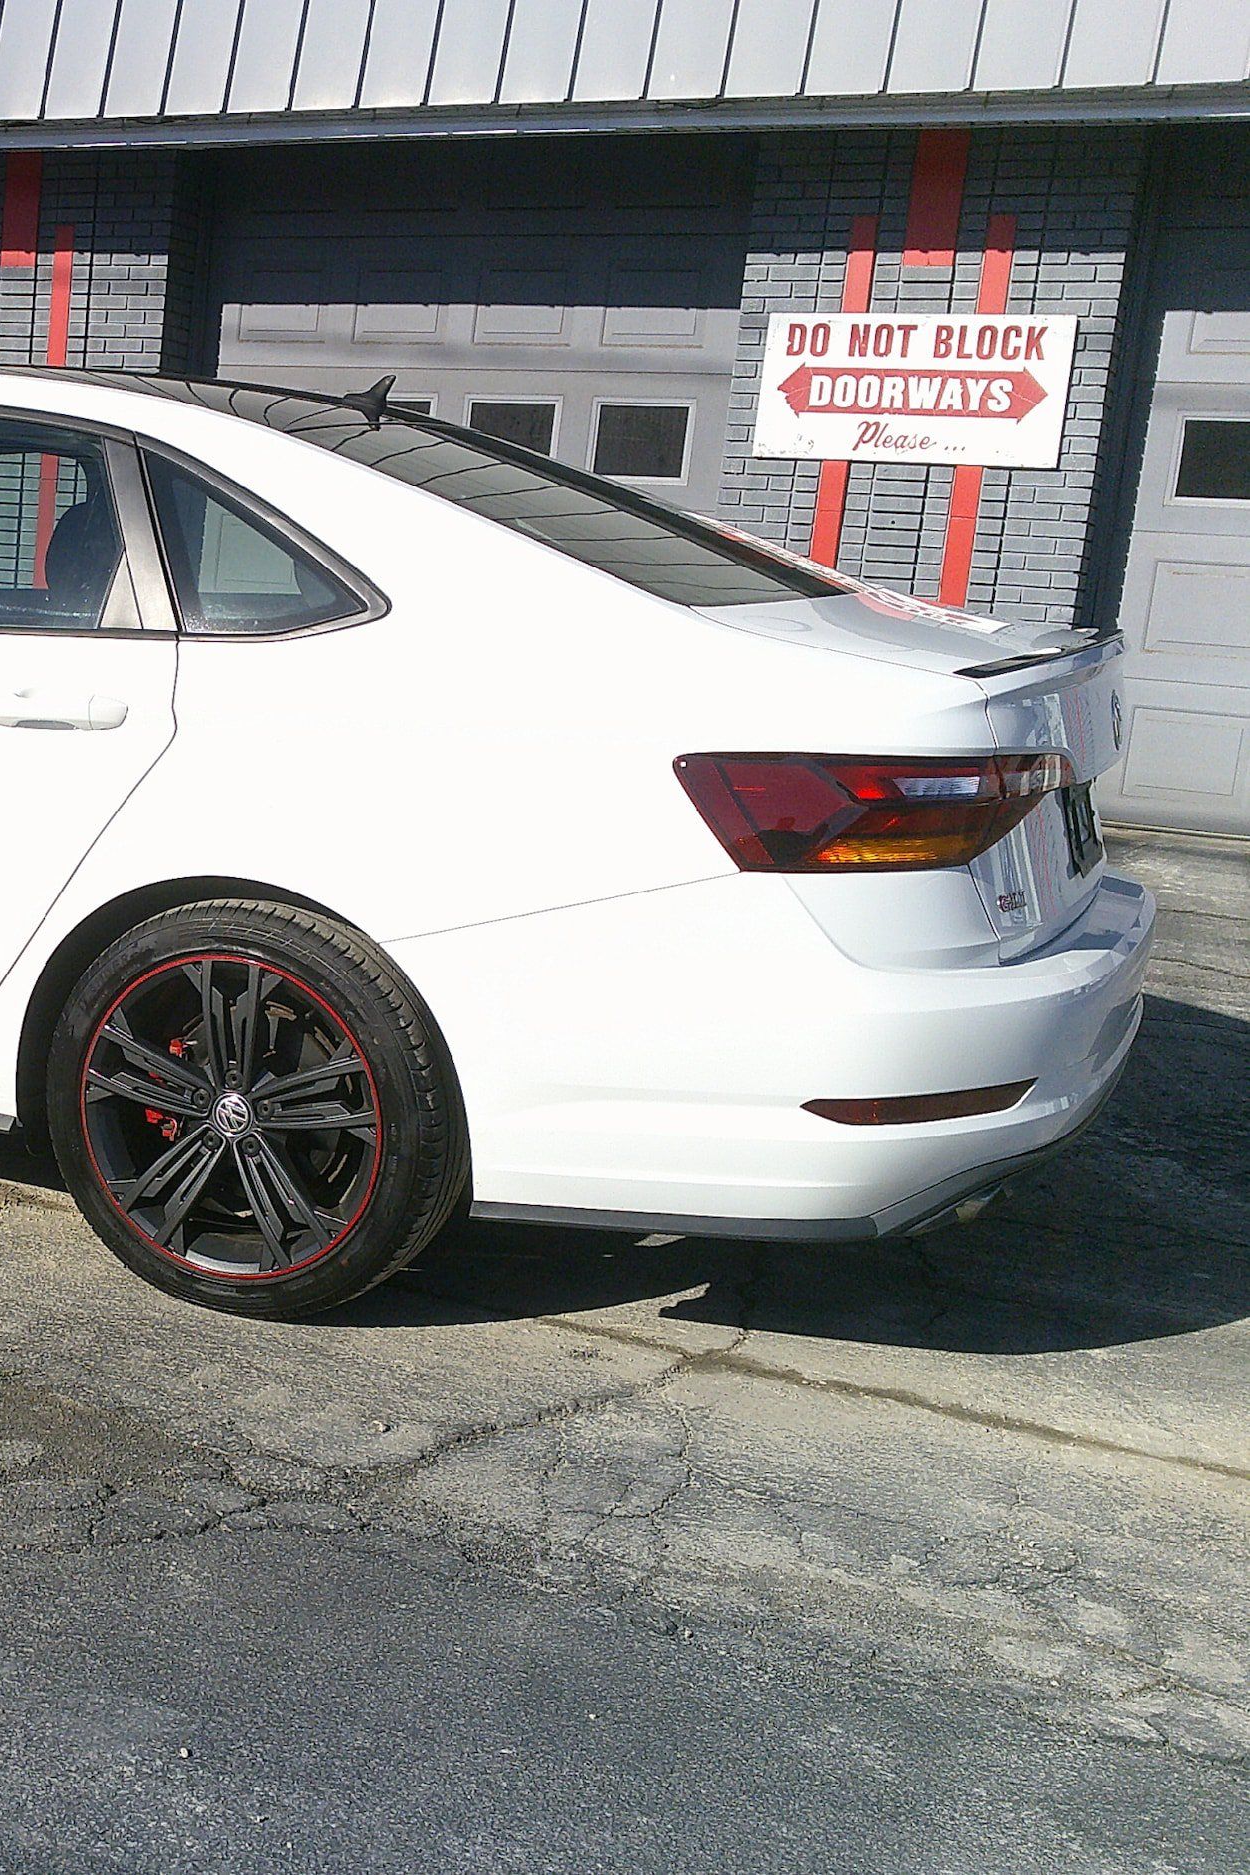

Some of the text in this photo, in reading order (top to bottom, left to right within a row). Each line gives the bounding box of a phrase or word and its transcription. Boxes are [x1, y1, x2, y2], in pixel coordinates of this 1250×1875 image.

[785, 323, 1049, 360] DO NOT BLOCK
[807, 373, 1014, 413] DOORWAYS
[852, 420, 937, 451] Please
